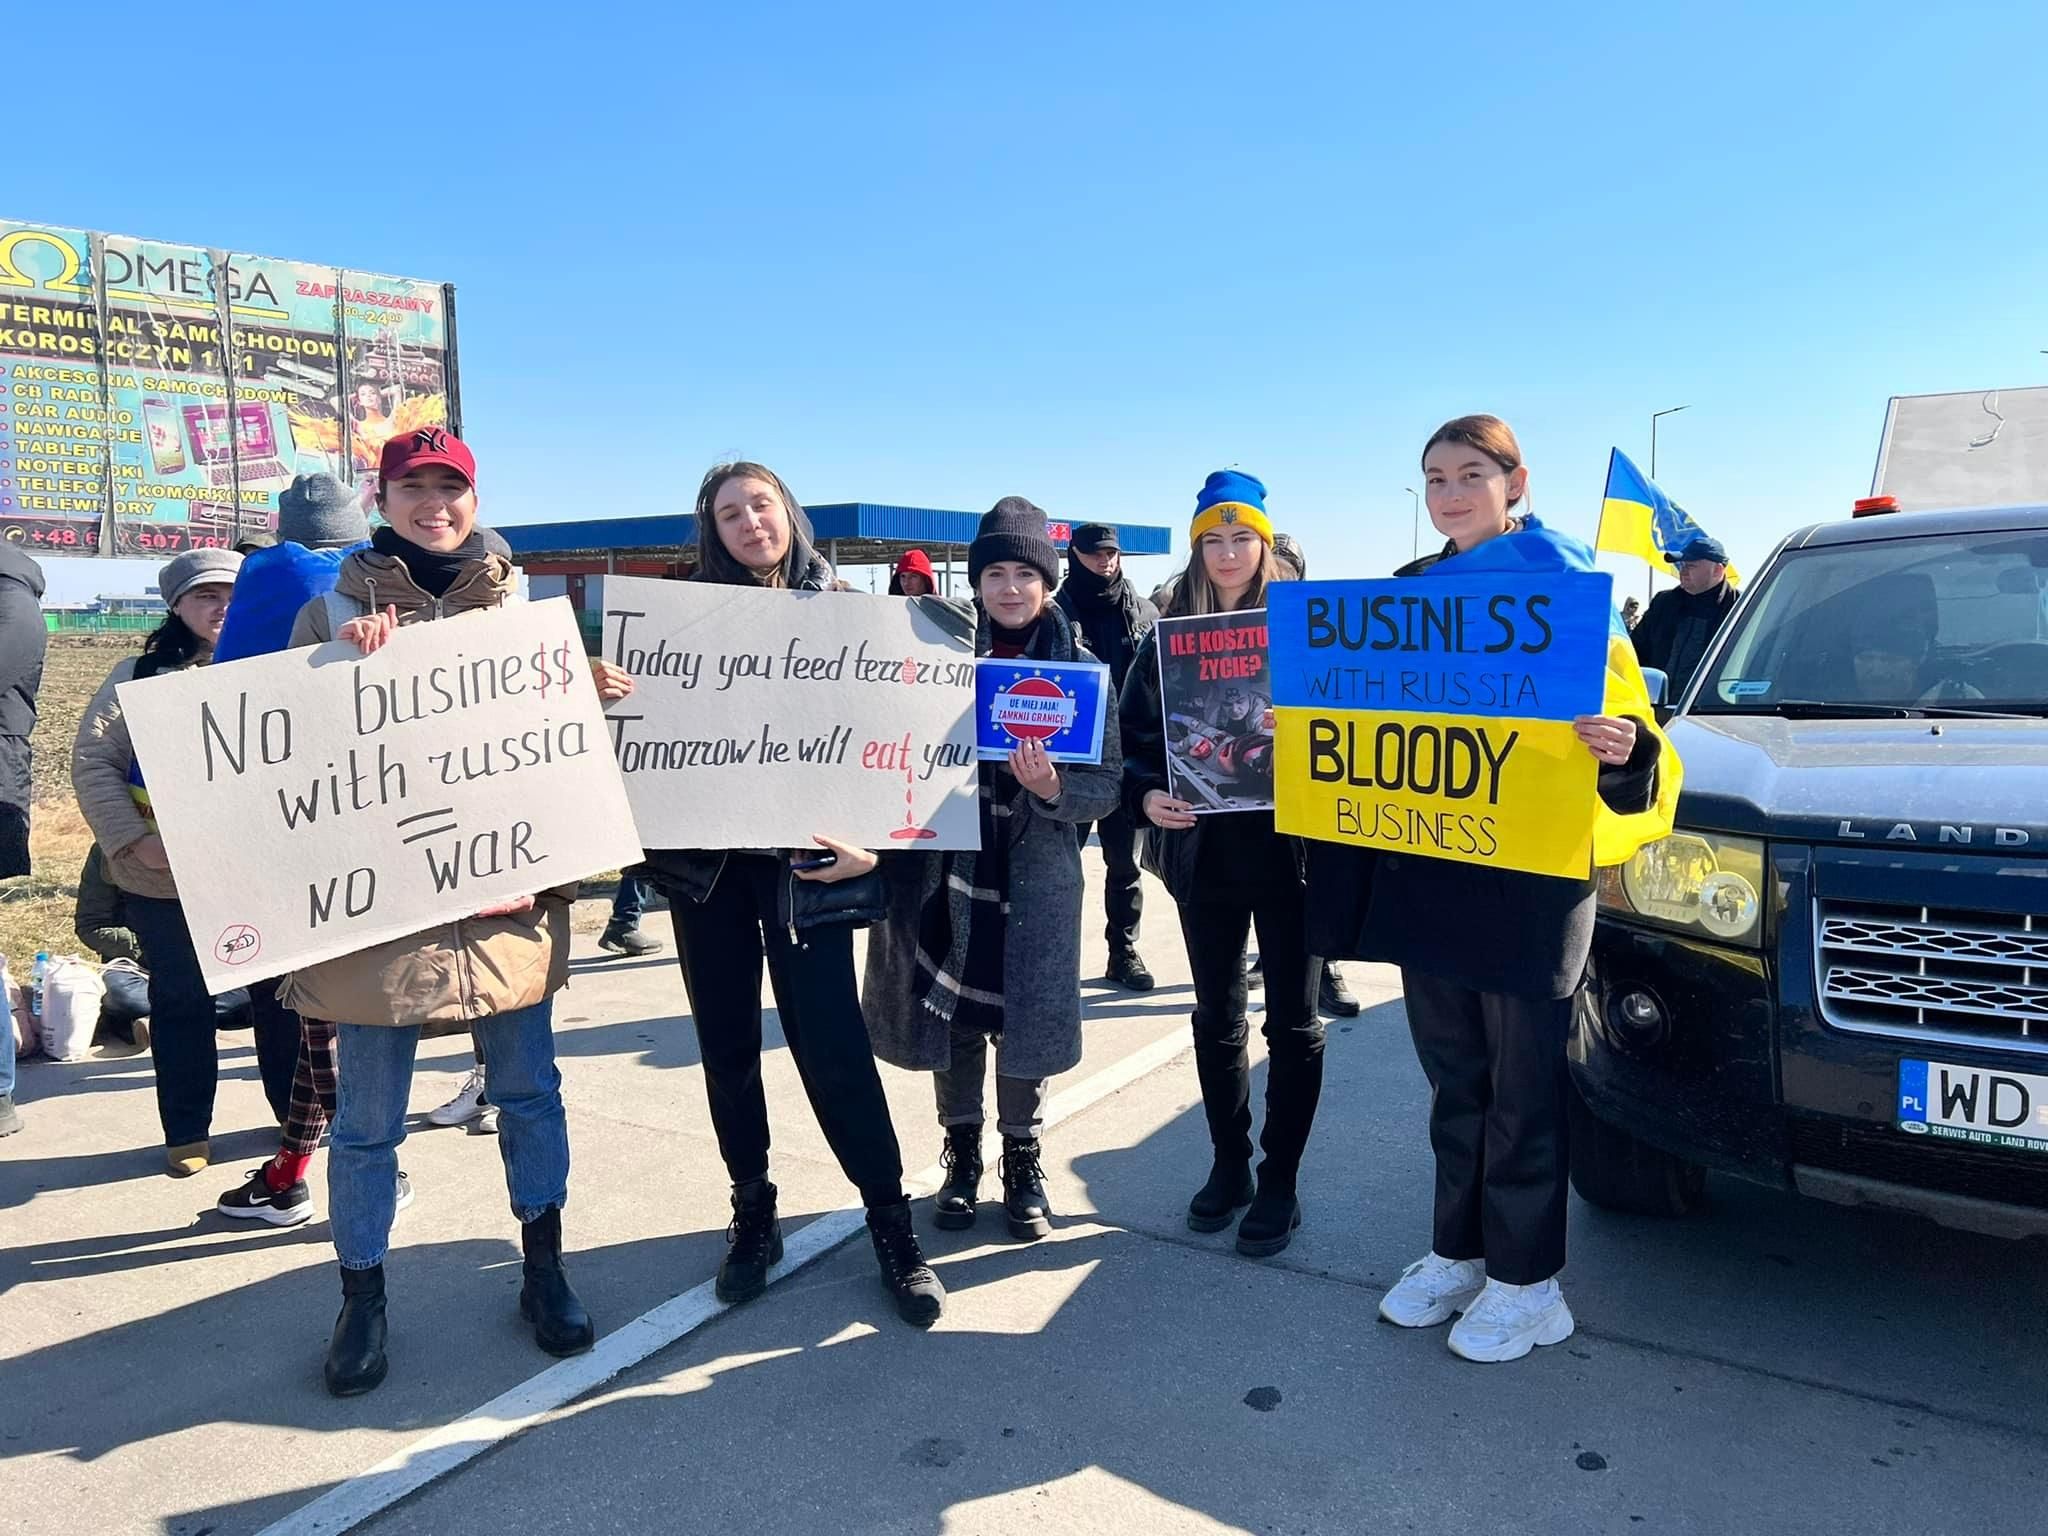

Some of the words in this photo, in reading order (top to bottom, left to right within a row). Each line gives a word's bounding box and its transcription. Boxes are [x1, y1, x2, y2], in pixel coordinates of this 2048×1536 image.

[296, 280, 434, 313] ZAPRASZAMY
[13, 383, 43, 398] CB
[14, 403, 58, 418] CAR
[66, 407, 132, 424] AUDIO
[15, 421, 142, 443] NAWIGACJE
[16, 477, 129, 496] TELEFOY
[18, 495, 156, 514] TELEWIORY
[31, 528, 76, 545] +48
[139, 533, 181, 548] 507
[1306, 595, 1553, 654] BUSINESS
[607, 610, 702, 689] Today
[716, 653, 772, 691] you
[780, 637, 848, 681] feed
[1169, 633, 1196, 656] ILE
[1199, 654, 1263, 681] ŻYCIE?
[1302, 667, 1386, 701] WITH
[1401, 671, 1541, 708] RUSSIA
[998, 710, 1030, 722] ZAMKNIJ
[1009, 698, 1019, 708] UE
[1021, 699, 1038, 711] MIEJ
[1038, 700, 1060, 711] JAJA!
[200, 691, 293, 783] No
[605, 714, 756, 773] Tomorrow
[759, 723, 790, 764] he
[799, 725, 853, 765] will
[861, 732, 912, 772] eat
[918, 741, 972, 781] you
[277, 743, 408, 831] with
[427, 716, 590, 785] russia
[1309, 719, 1519, 804] BLOODY
[1337, 798, 1498, 856] BUSINESS
[1838, 820, 2030, 847] LAND
[308, 867, 376, 928] NO
[1902, 1096, 1923, 1111] PL
[1941, 1069, 2030, 1128] WD
[1932, 1125, 1967, 1139] SERWIS
[1968, 1131, 1992, 1143] AUTO
[2000, 1135, 2025, 1148] LAND
